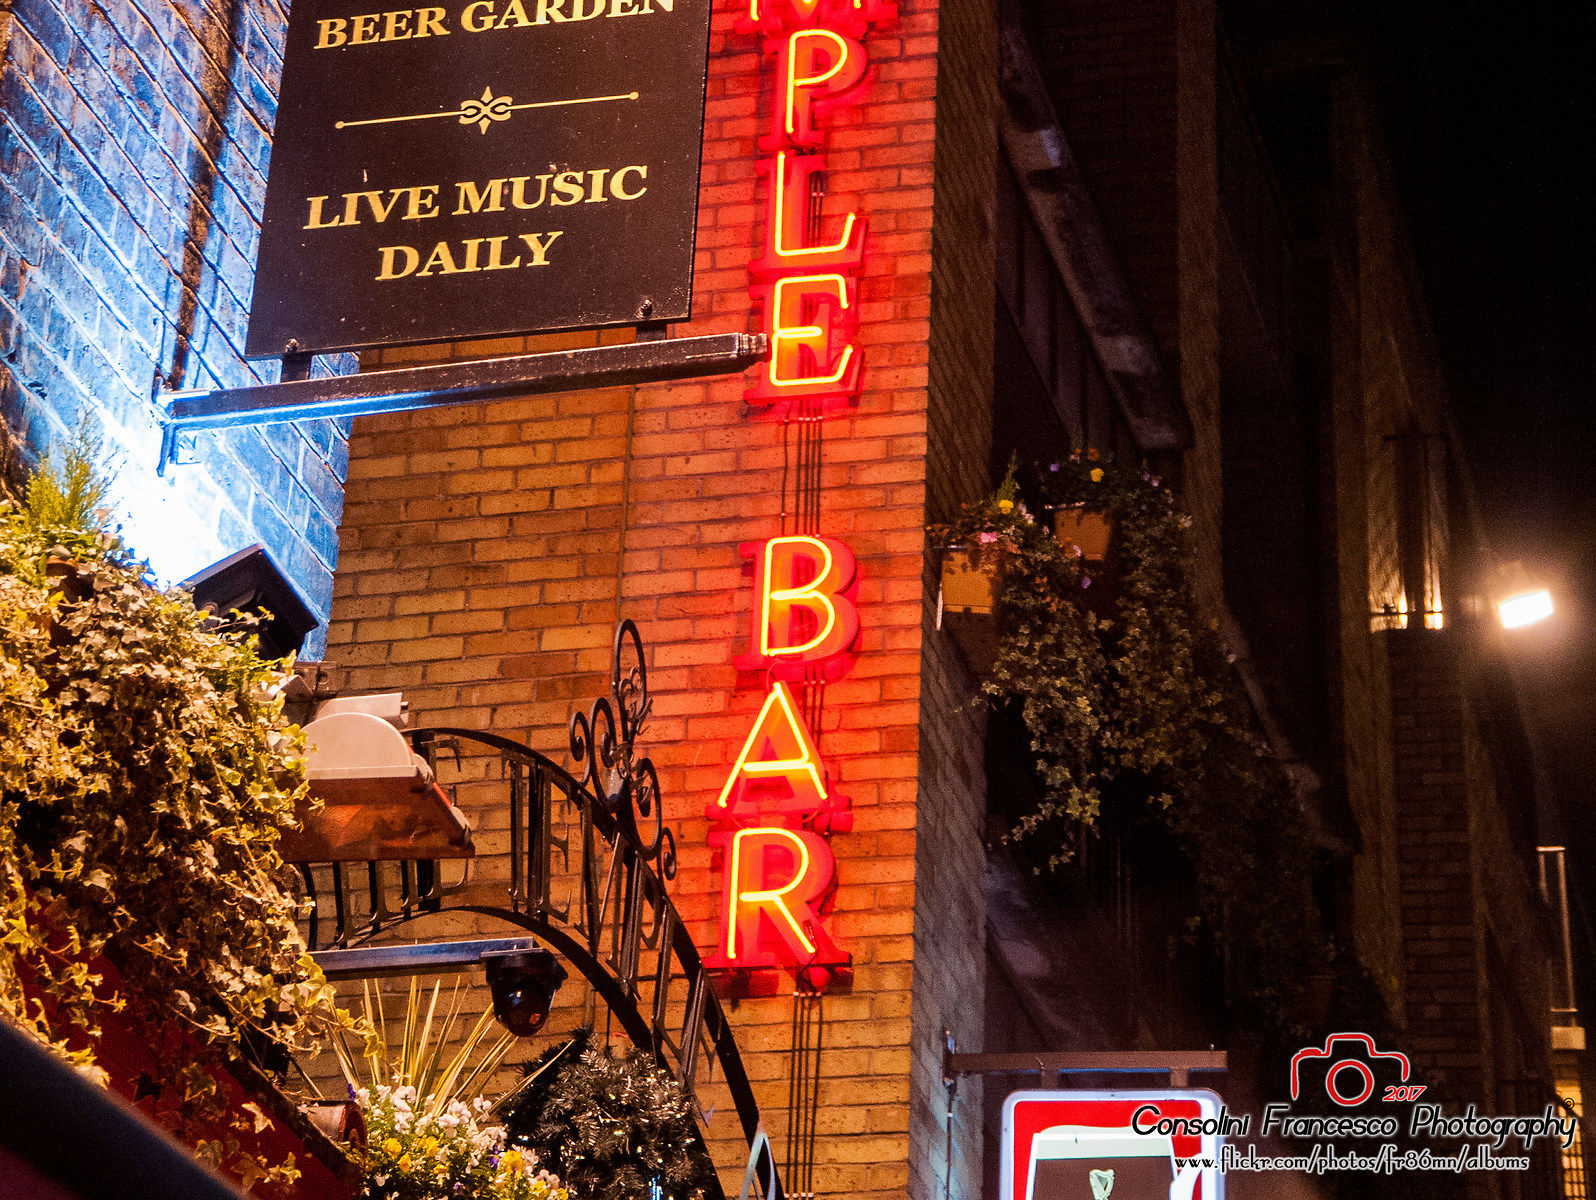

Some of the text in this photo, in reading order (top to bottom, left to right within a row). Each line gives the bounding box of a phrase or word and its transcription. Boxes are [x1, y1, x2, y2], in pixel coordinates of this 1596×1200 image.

[313, 6, 450, 50] BEER
[303, 164, 649, 230] LIVE MUSIC
[374, 230, 564, 282] DAILY
[712, 534, 848, 962] BAR
